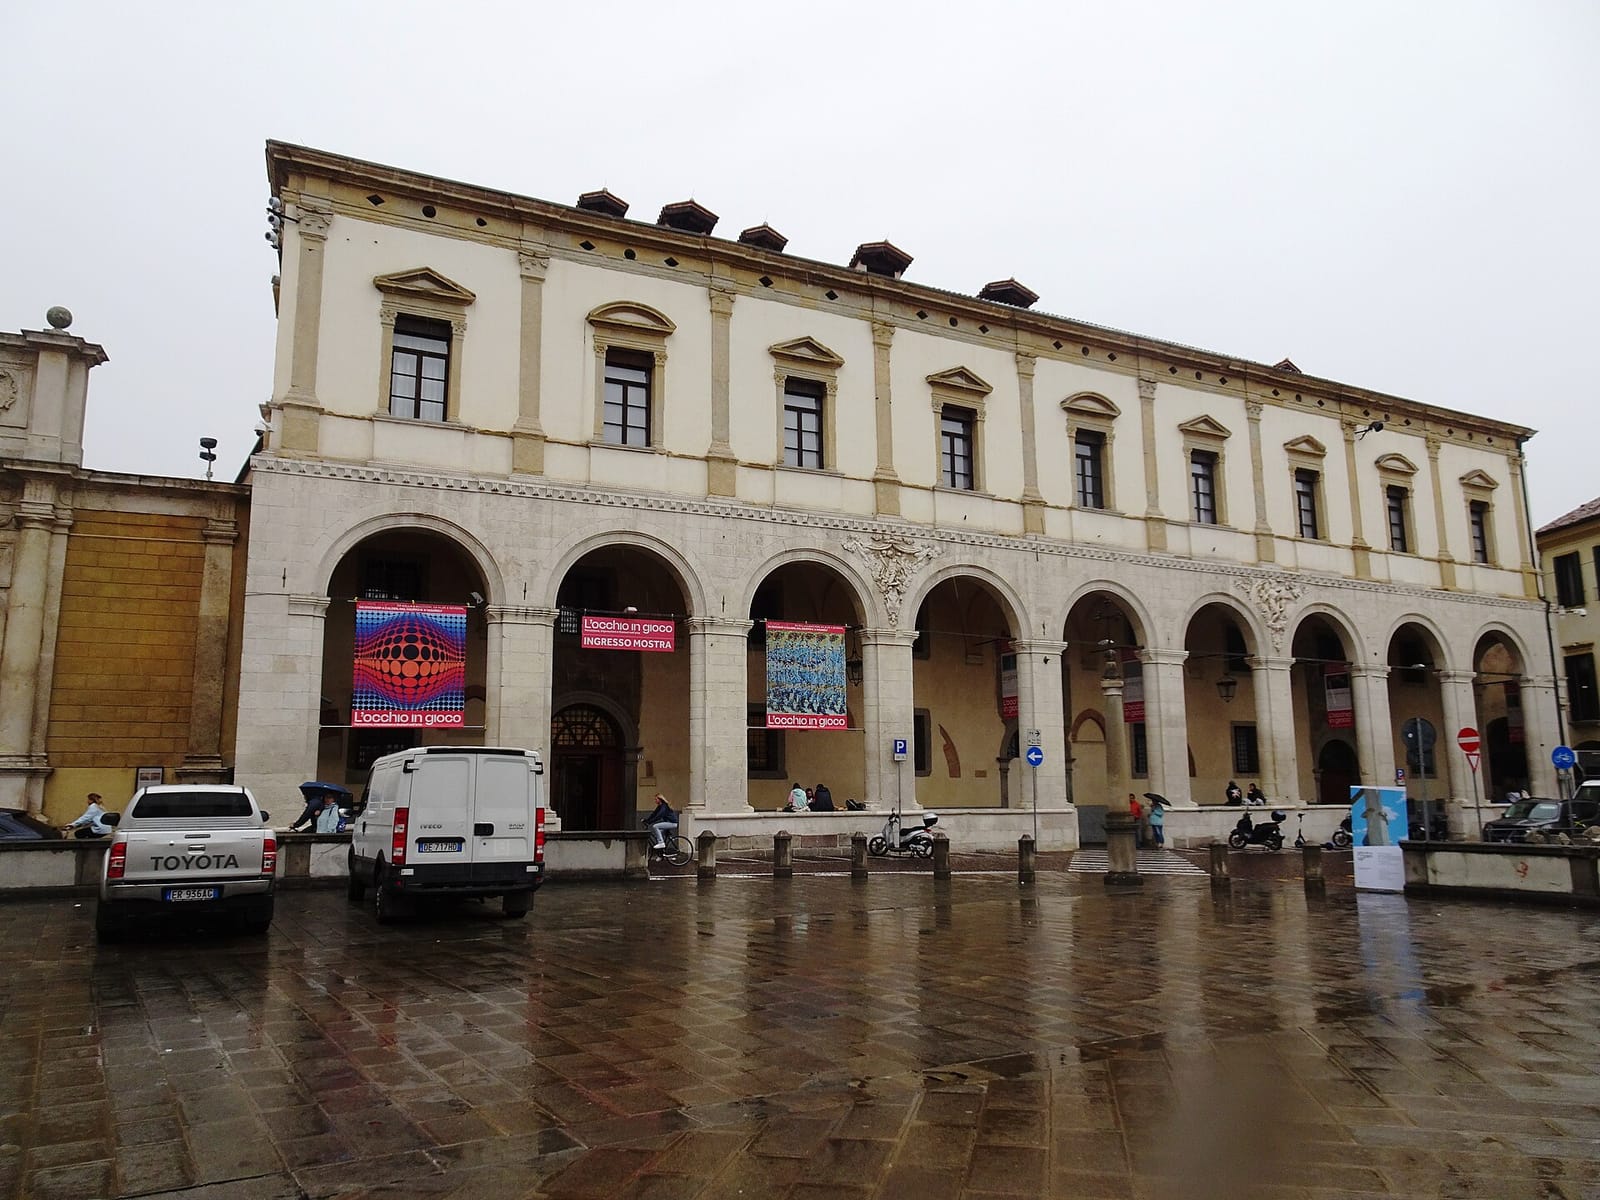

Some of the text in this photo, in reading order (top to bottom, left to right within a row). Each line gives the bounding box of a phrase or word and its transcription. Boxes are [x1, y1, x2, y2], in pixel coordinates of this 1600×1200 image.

[584, 619, 630, 630] L'occhio
[631, 623, 641, 631] in
[642, 624, 673, 634] gioco
[583, 636, 672, 649] INGRESSO MOSTRA
[354, 711, 462, 726] L'occhio in gioco
[767, 715, 808, 725] L'occhio
[818, 718, 846, 728] gioco
[896, 741, 905, 753] P
[150, 855, 240, 871] TOYOTA
[171, 890, 183, 899] ER
